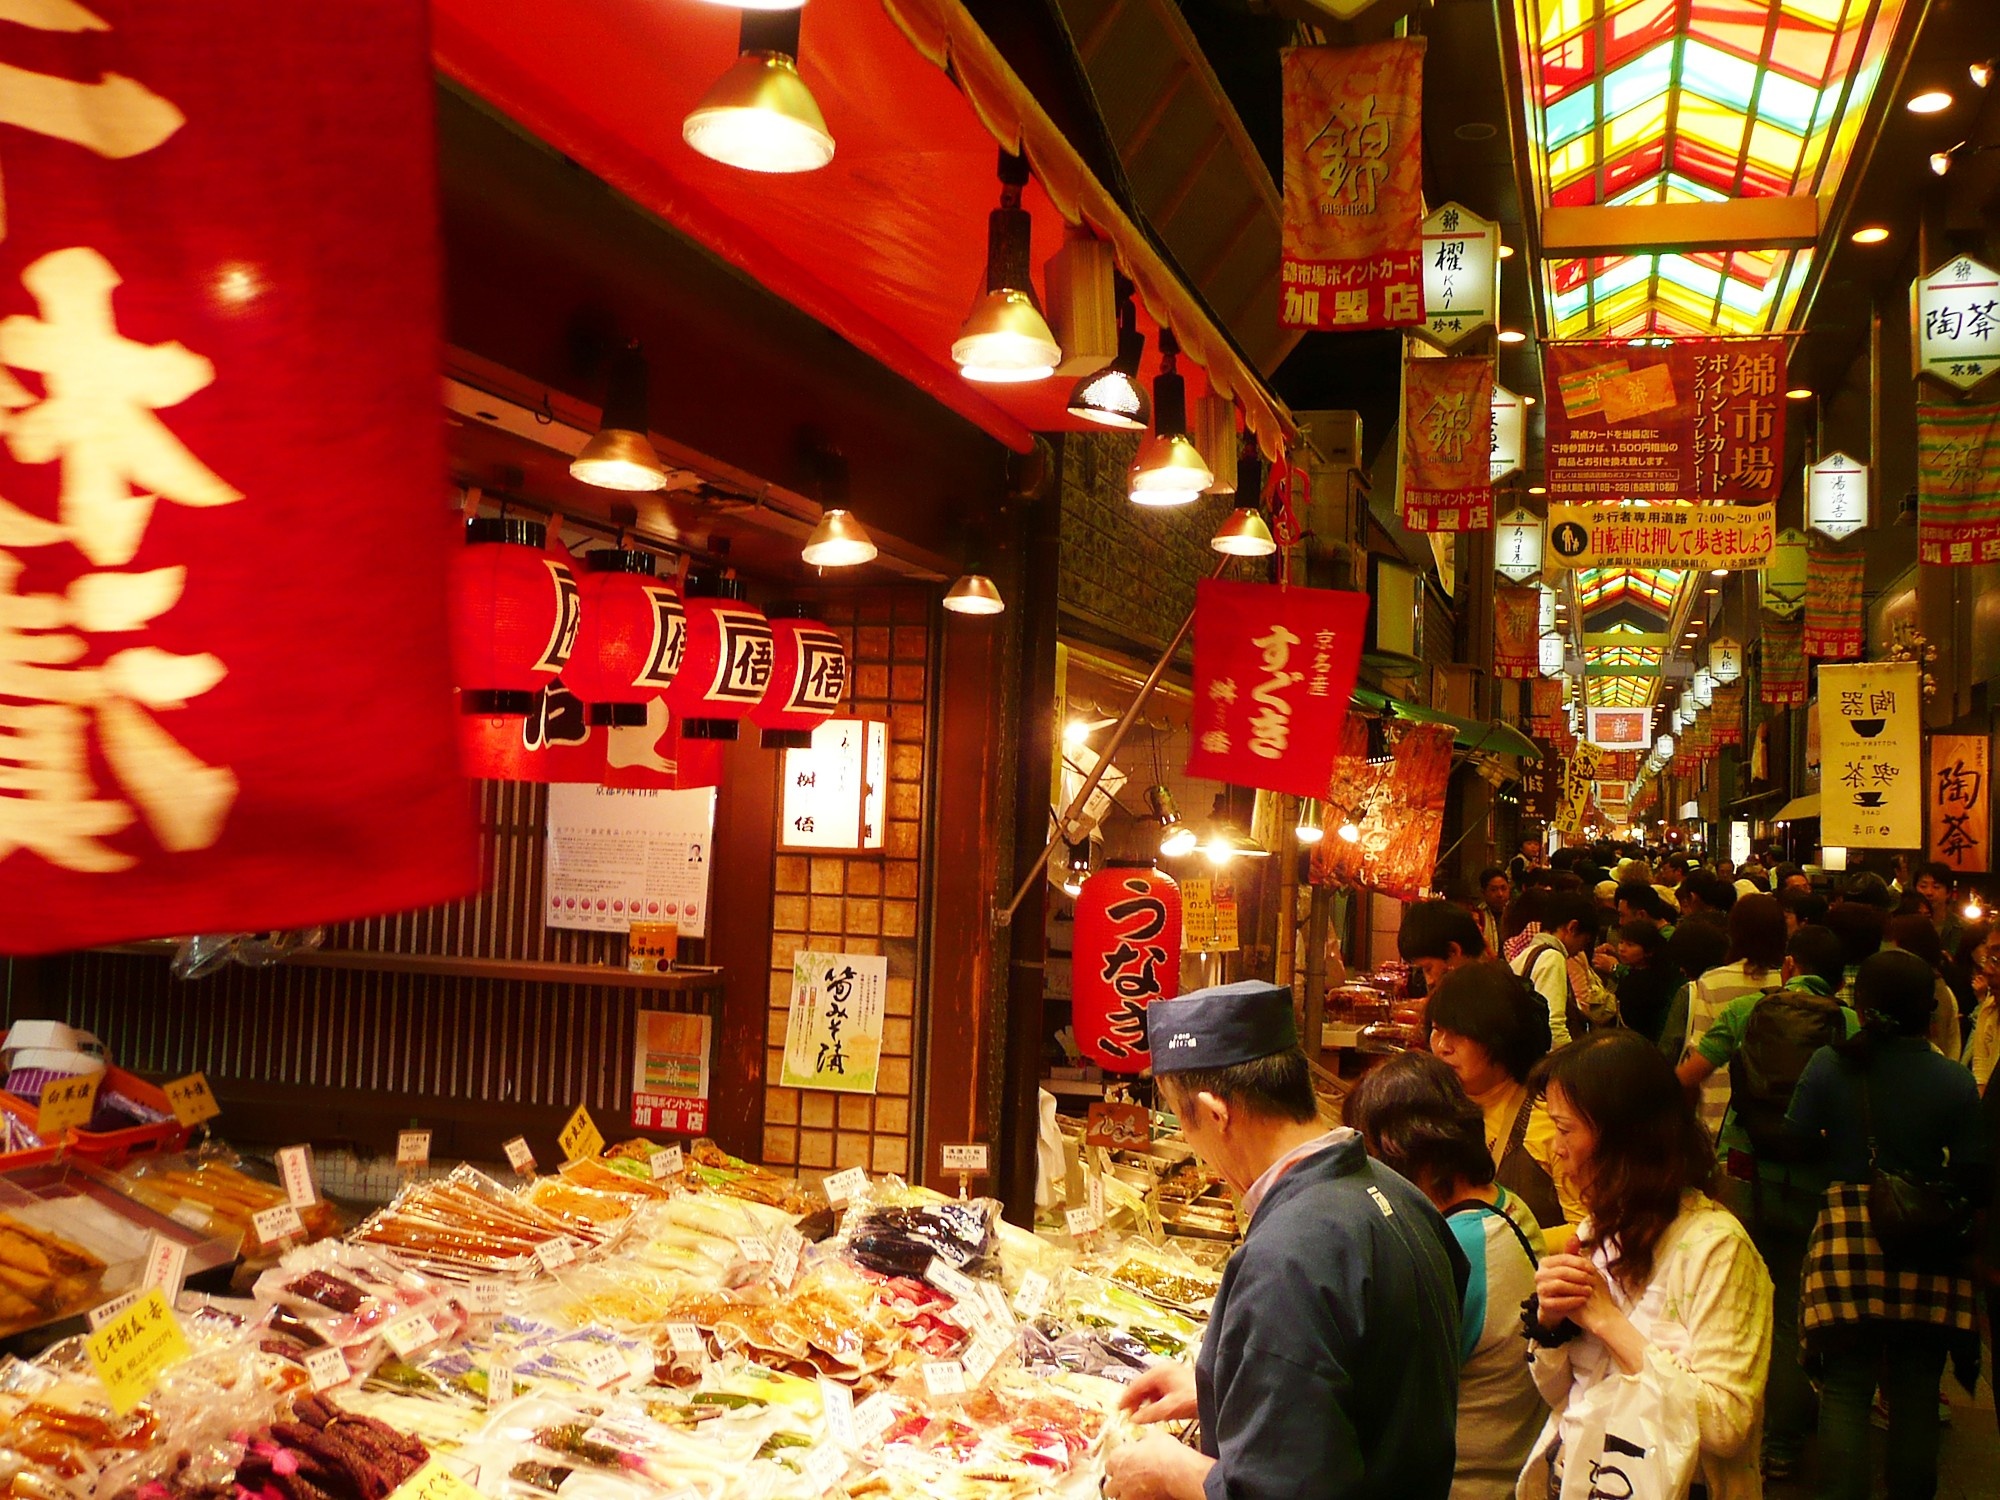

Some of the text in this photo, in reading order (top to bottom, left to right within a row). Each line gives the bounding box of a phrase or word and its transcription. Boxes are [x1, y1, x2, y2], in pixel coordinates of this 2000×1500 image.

[1283, 254, 1422, 287] 錦市場ポイントカード
[1442, 274, 1454, 310] KAI
[1282, 282, 1419, 326] 加盟店
[1693, 354, 1706, 492] マンスリープレゼント！
[1708, 354, 1730, 494] ポイントカード
[1730, 352, 1778, 490] 錦市場
[1407, 506, 1489, 531] 加盟店
[1591, 525, 1774, 555] 自転車は押して歩きましょう
[1593, 511, 1688, 525] 歩行者専用道路
[1306, 628, 1337, 697] 京名産
[1248, 624, 1305, 761] すぐき
[1097, 878, 1168, 1058] うなぎ
[634, 1107, 705, 1131] 加盟店
